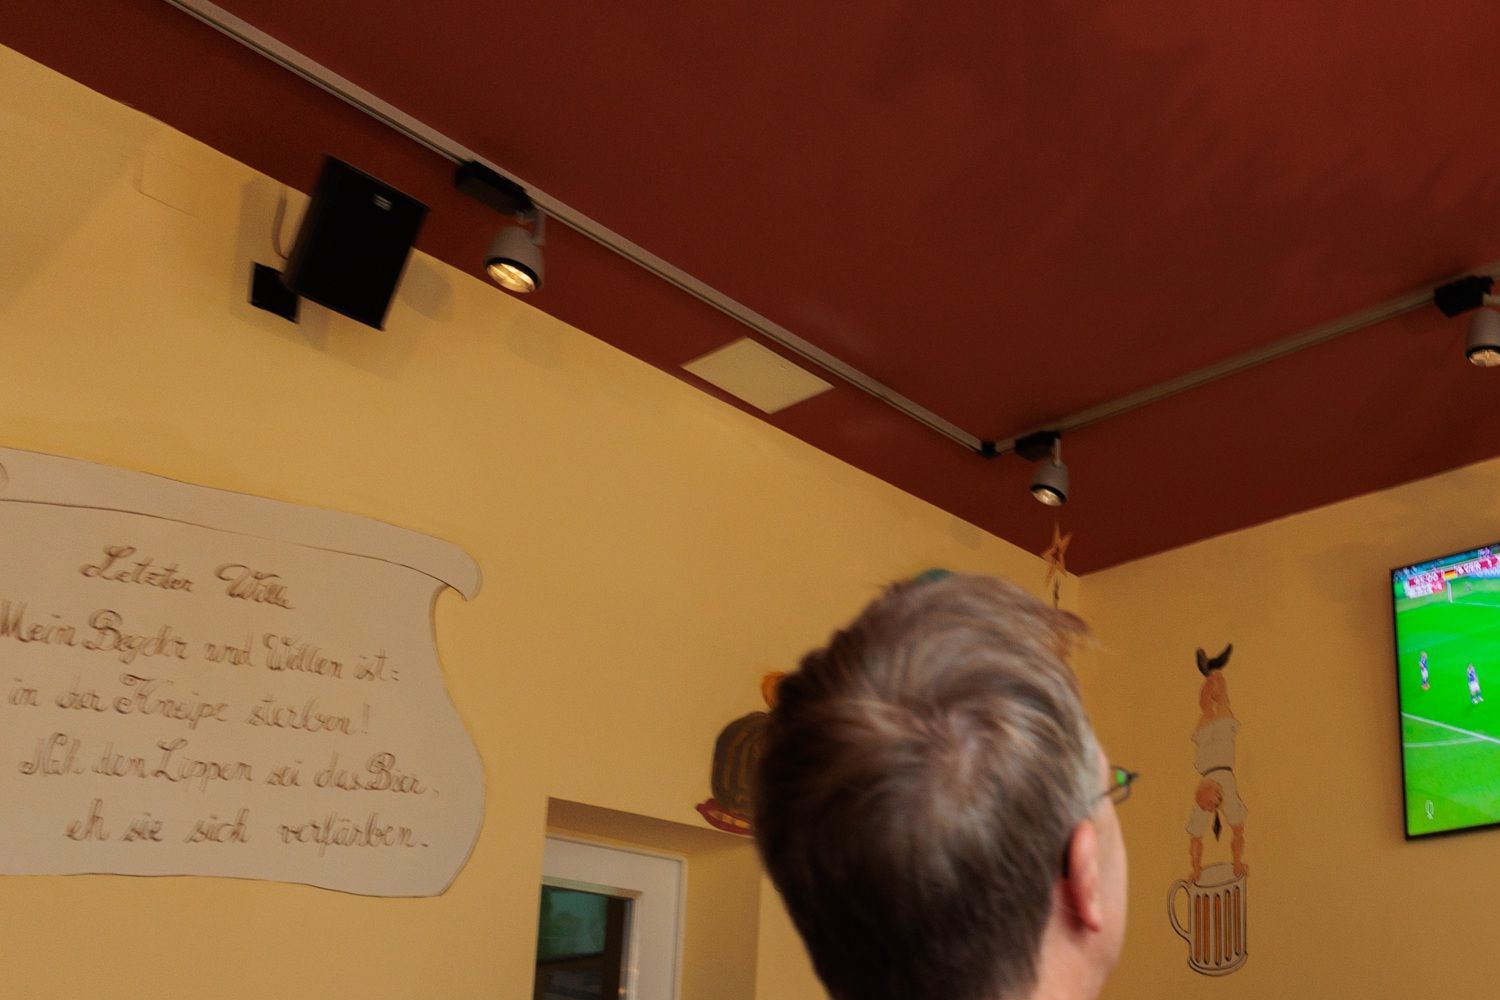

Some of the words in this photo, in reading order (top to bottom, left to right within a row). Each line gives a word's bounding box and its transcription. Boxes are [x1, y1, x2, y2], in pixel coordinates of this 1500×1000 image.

[79, 545, 194, 592] Letzter
[0, 600, 77, 648] Mein
[8, 677, 40, 707] in
